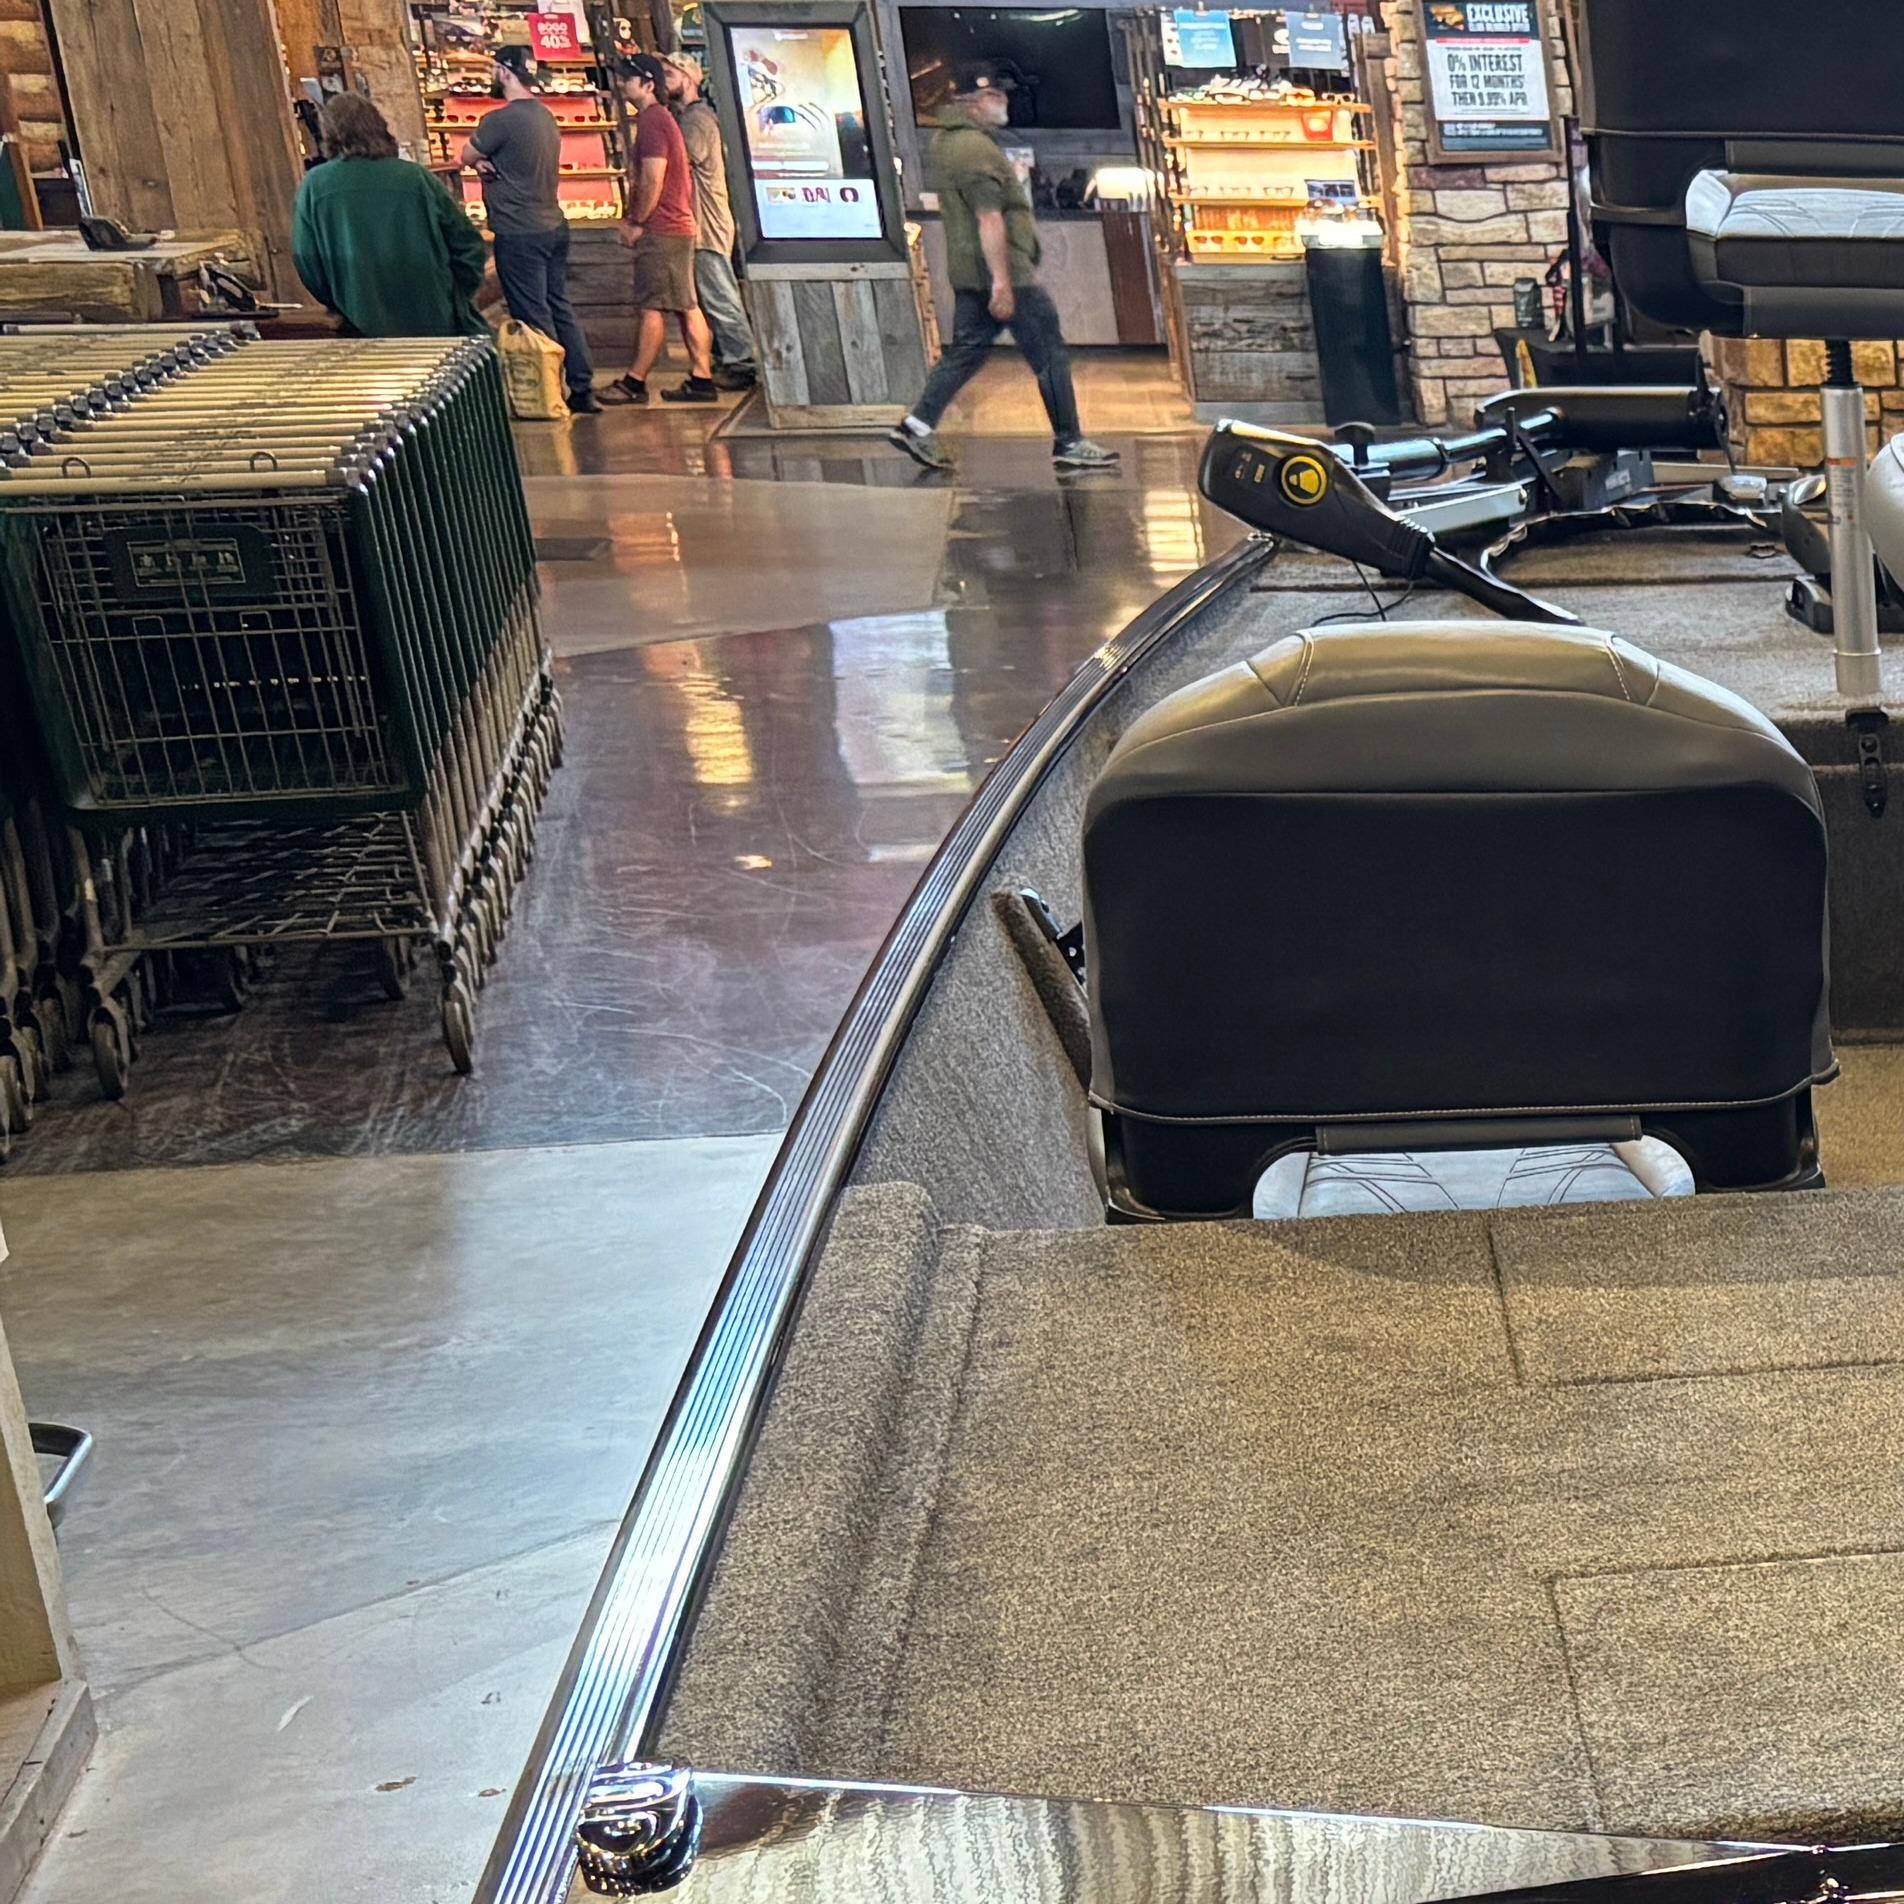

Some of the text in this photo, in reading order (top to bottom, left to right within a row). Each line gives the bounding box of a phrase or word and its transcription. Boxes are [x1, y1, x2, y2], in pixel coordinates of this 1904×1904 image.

[1447, 53, 1522, 72] 0% INTEREST
[1449, 74, 1468, 89] FOR
[1451, 91, 1476, 106] THEN
[1509, 91, 1528, 106] APR
